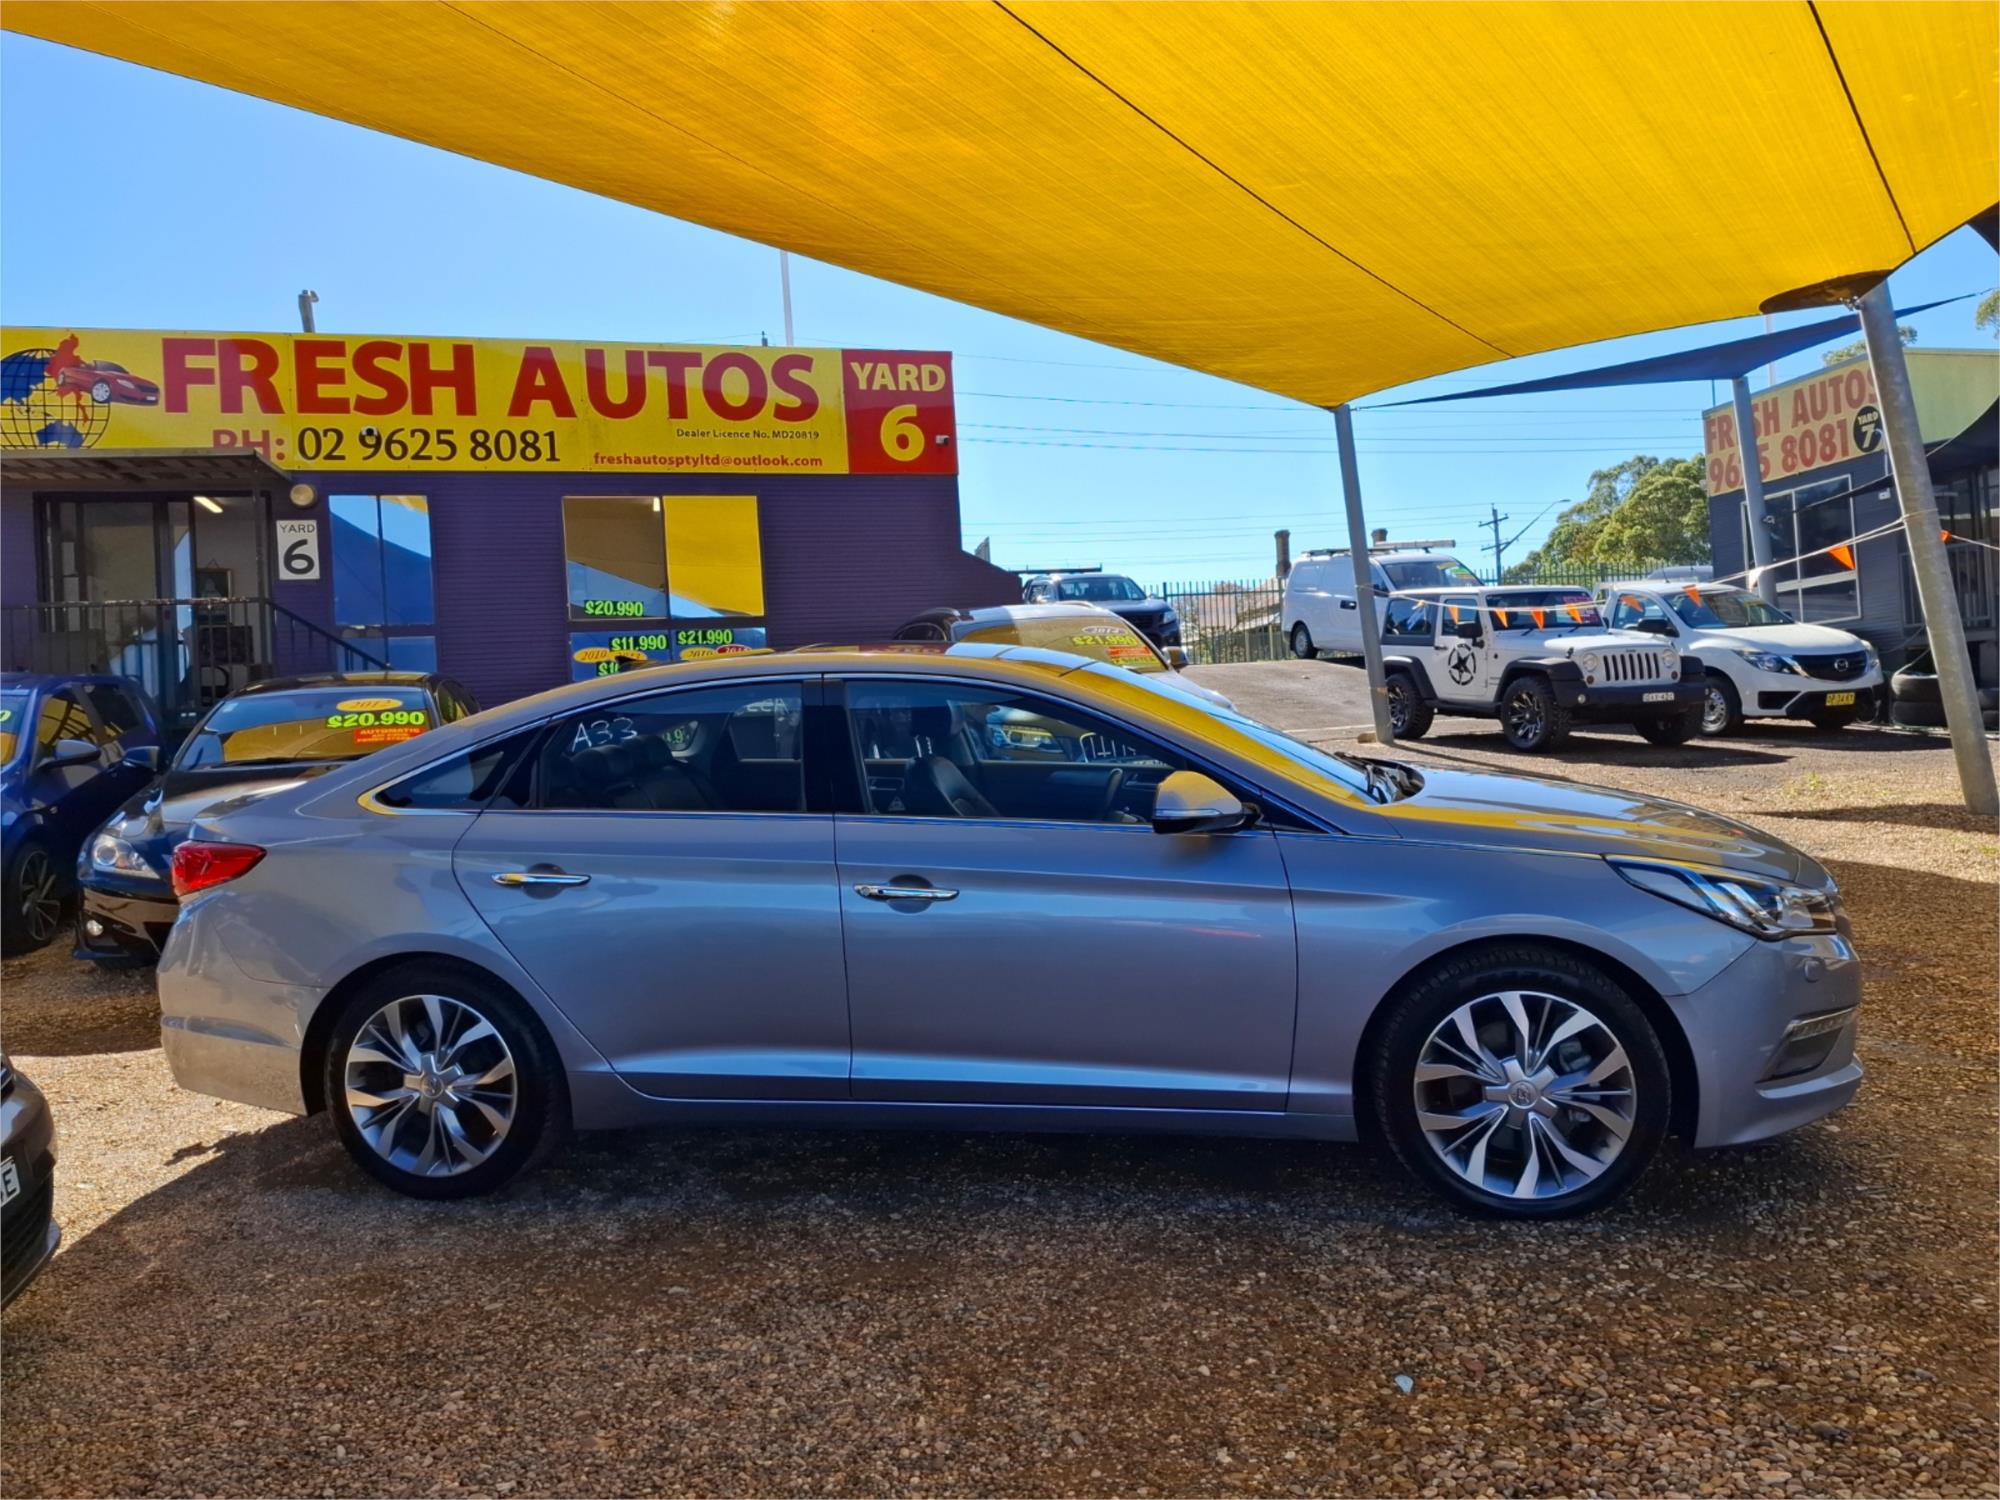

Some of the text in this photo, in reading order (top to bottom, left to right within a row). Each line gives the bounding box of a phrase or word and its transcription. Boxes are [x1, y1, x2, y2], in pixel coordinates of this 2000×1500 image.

[162, 337, 820, 423] FRESH AUTOS
[850, 362, 946, 392] YARD
[1705, 397, 1781, 455] FRSH
[1857, 411, 1879, 425] YARD
[297, 427, 346, 461] 02
[358, 427, 458, 462] 9625
[469, 428, 561, 462] 8081
[676, 428, 820, 440] Dealer Licence No. MD20819
[880, 404, 926, 461] 6
[1861, 423, 1876, 448] 7
[593, 452, 823, 468] freshautosptyltd@outlook.com
[1708, 418, 1850, 494] 965 8081
[280, 523, 316, 534] YARD
[283, 538, 315, 576] 6
[584, 600, 645, 618] $20.990
[611, 634, 667, 652] $11.990
[677, 629, 733, 646] $21.990
[327, 710, 426, 728] $20.990
[571, 716, 638, 752] A33
